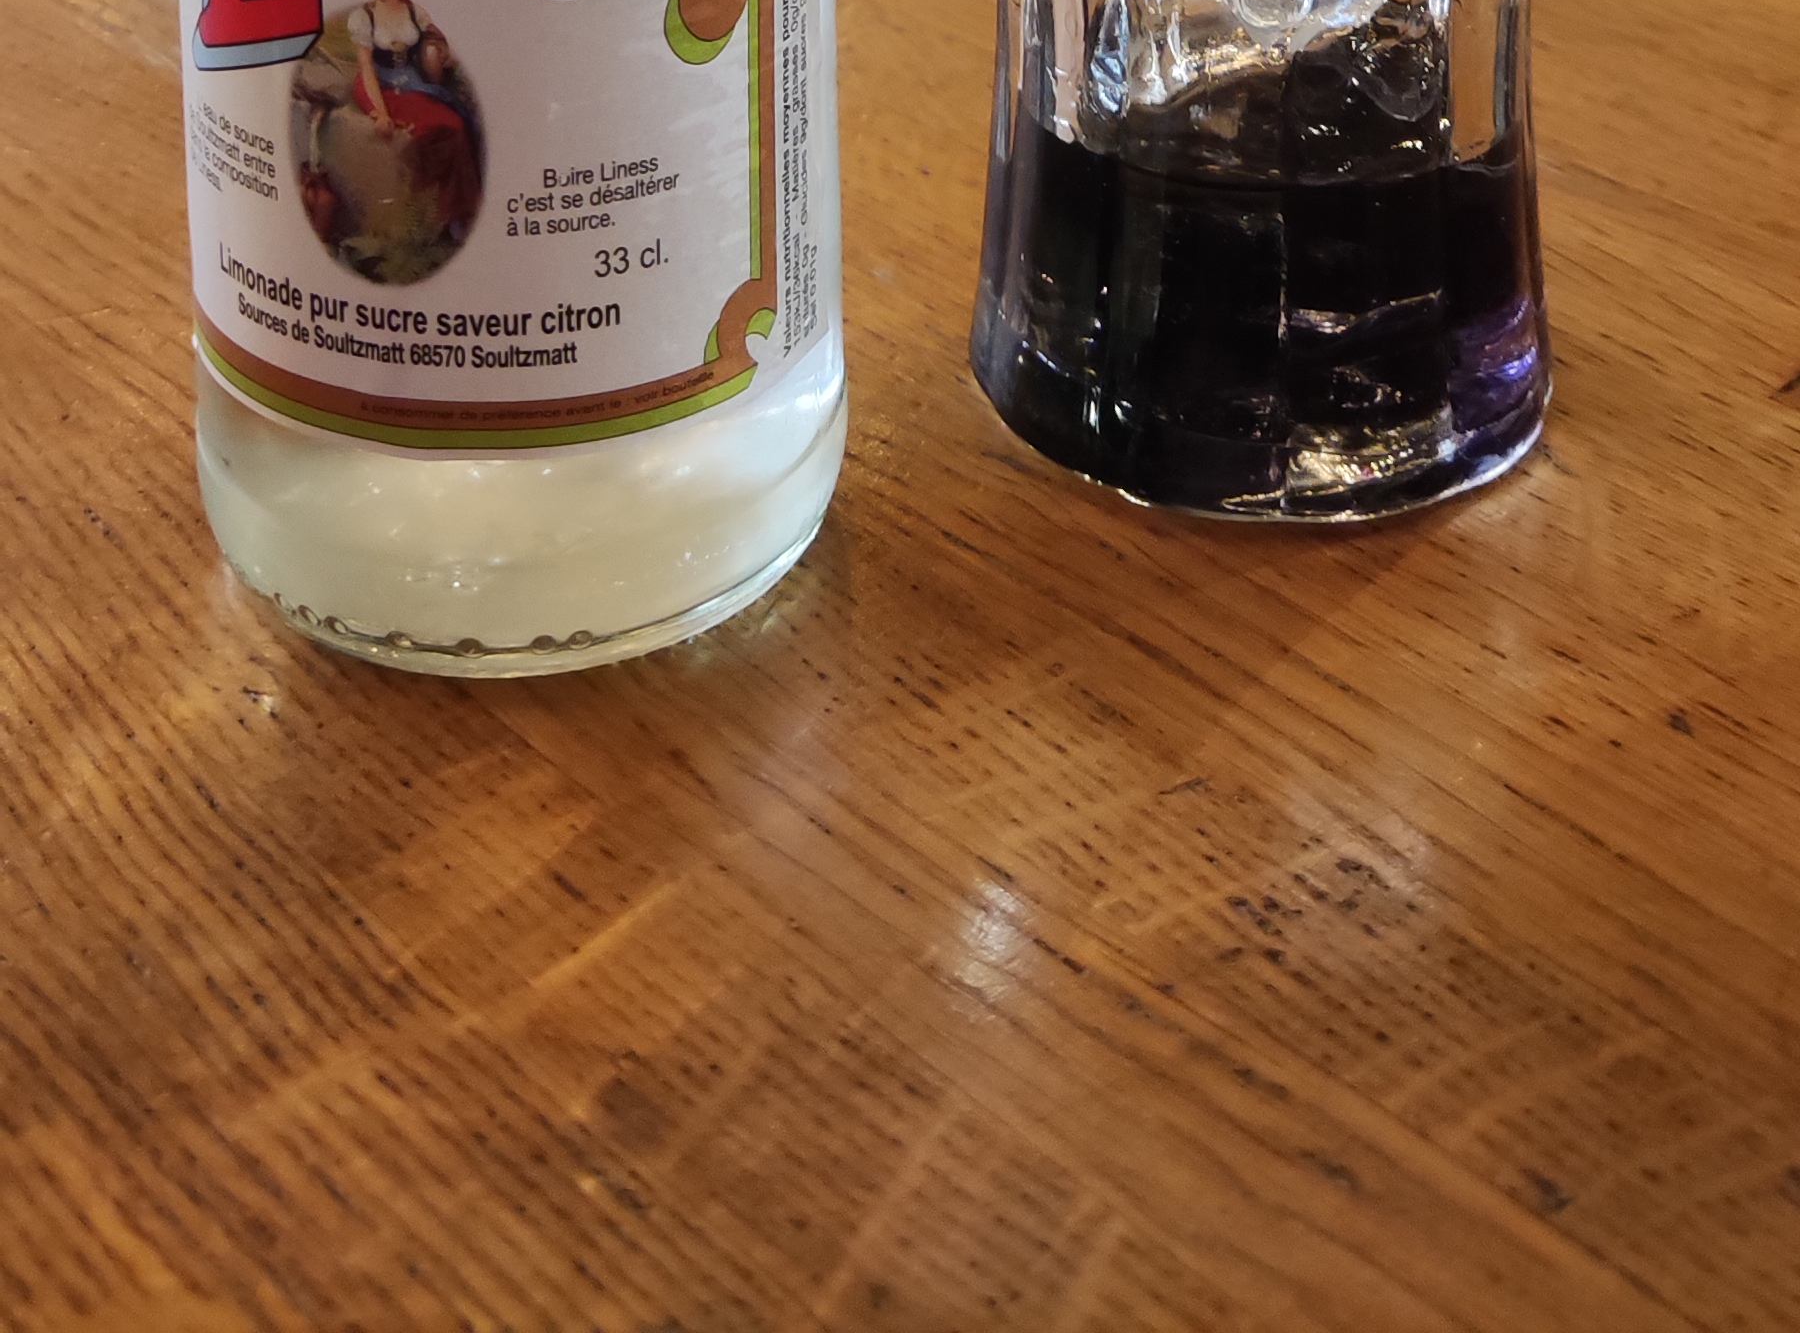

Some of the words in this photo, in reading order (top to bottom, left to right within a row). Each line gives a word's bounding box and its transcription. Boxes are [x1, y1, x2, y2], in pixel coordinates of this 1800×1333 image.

[782, 0, 791, 42] pour
[783, 46, 792, 144] moyennes
[791, 44, 801, 113] grasses
[234, 124, 275, 156] source
[212, 152, 279, 202] composition
[244, 152, 276, 179] entre
[600, 157, 660, 183] Liness
[507, 192, 555, 213] c'est
[560, 192, 584, 210] se
[589, 173, 681, 207] désaltérer
[506, 216, 519, 237] à
[524, 216, 541, 236] la
[546, 212, 616, 235] source.
[782, 149, 791, 282] nutritionnelles
[594, 246, 631, 278] 33
[640, 238, 669, 269] cl.
[219, 241, 304, 311] Limonade
[309, 292, 349, 323] pur
[355, 303, 428, 334] sucre
[436, 312, 532, 337] saveur
[541, 303, 621, 335] citron
[238, 291, 288, 337] Sources
[291, 319, 310, 344] de
[314, 325, 406, 366] Soultzmatt
[410, 343, 466, 368] 68570
[471, 341, 578, 369] Soultzmatt
[783, 287, 792, 359] Valeurs
[634, 391, 659, 405] voir
